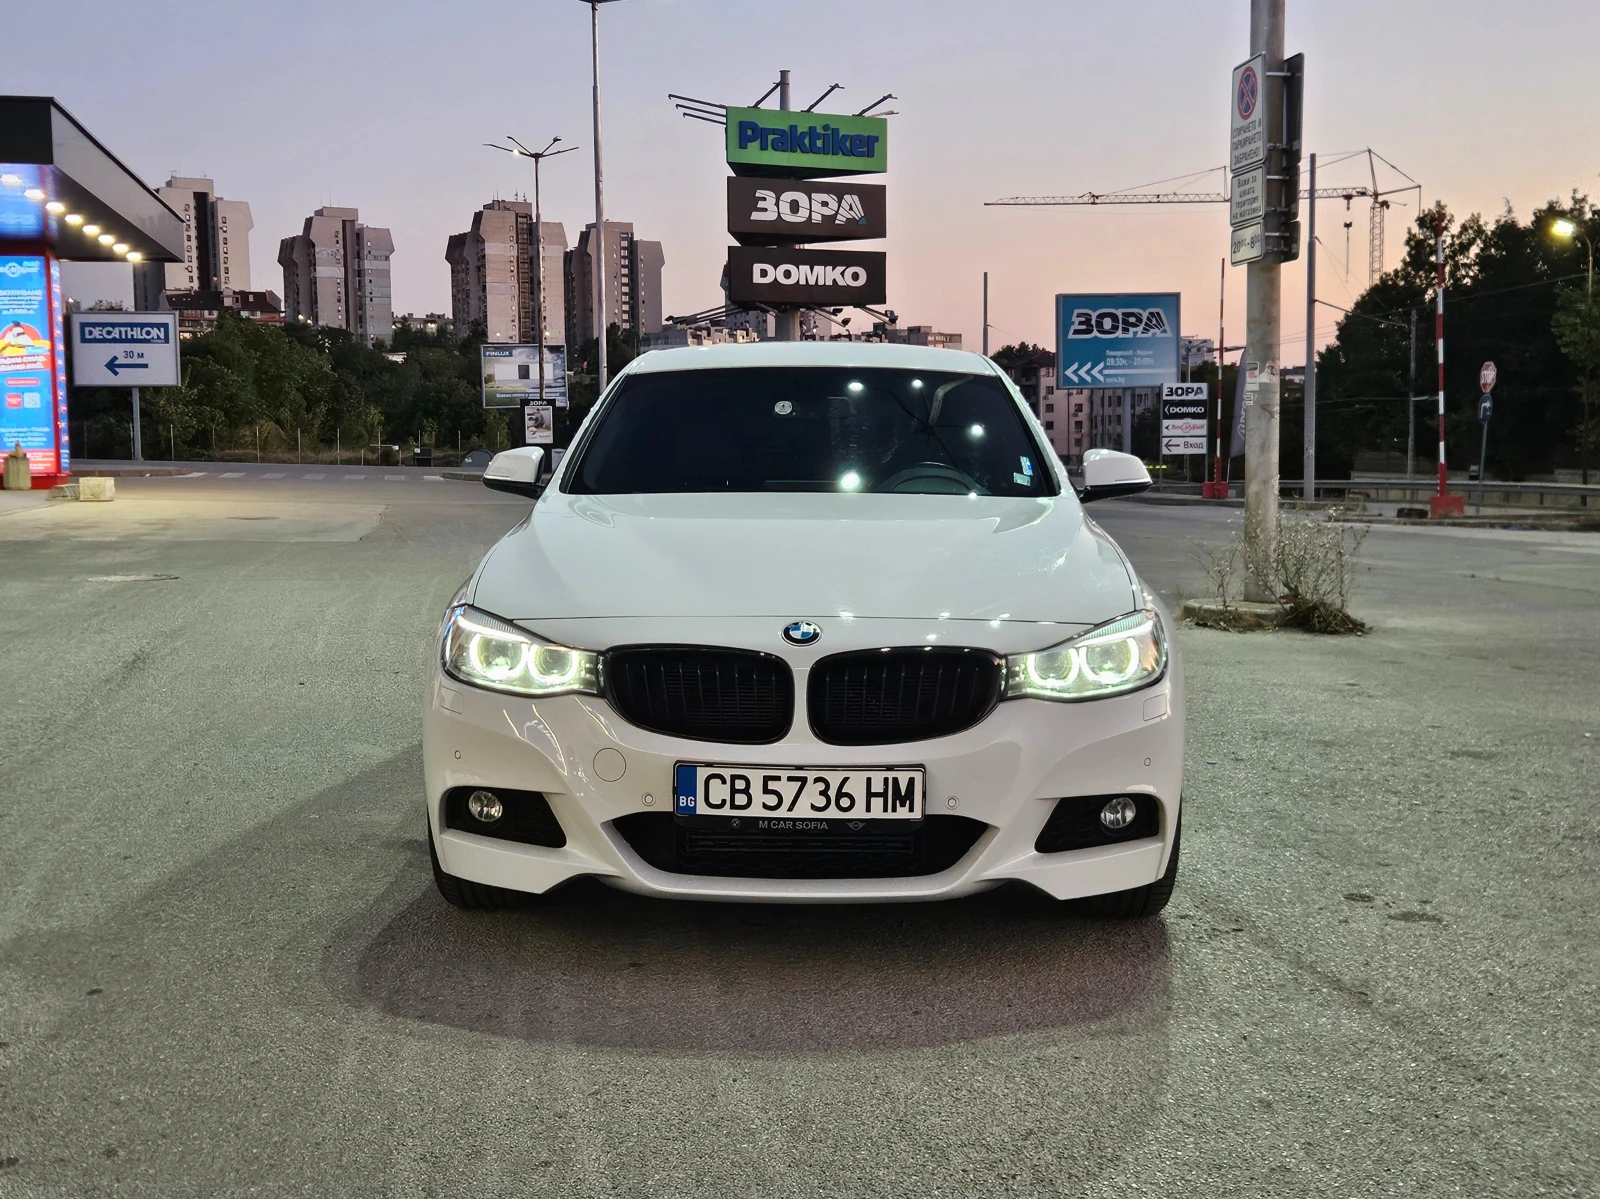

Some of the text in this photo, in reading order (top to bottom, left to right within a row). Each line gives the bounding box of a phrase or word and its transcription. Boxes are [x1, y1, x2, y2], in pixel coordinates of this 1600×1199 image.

[738, 120, 879, 158] Praktiker
[750, 189, 867, 225] ЗОРА
[752, 263, 867, 287] DOMKO
[1068, 308, 1171, 339] ЗОРА
[84, 326, 165, 340] DECATHLON
[123, 350, 135, 359] 30
[1165, 386, 1204, 397] ЗОРА
[1169, 406, 1205, 414] DOMKO
[1183, 441, 1204, 449] Вход
[703, 773, 916, 813] CB 5736 HM
[679, 796, 695, 807] BG
[758, 820, 829, 830] M CAR SOFIA
